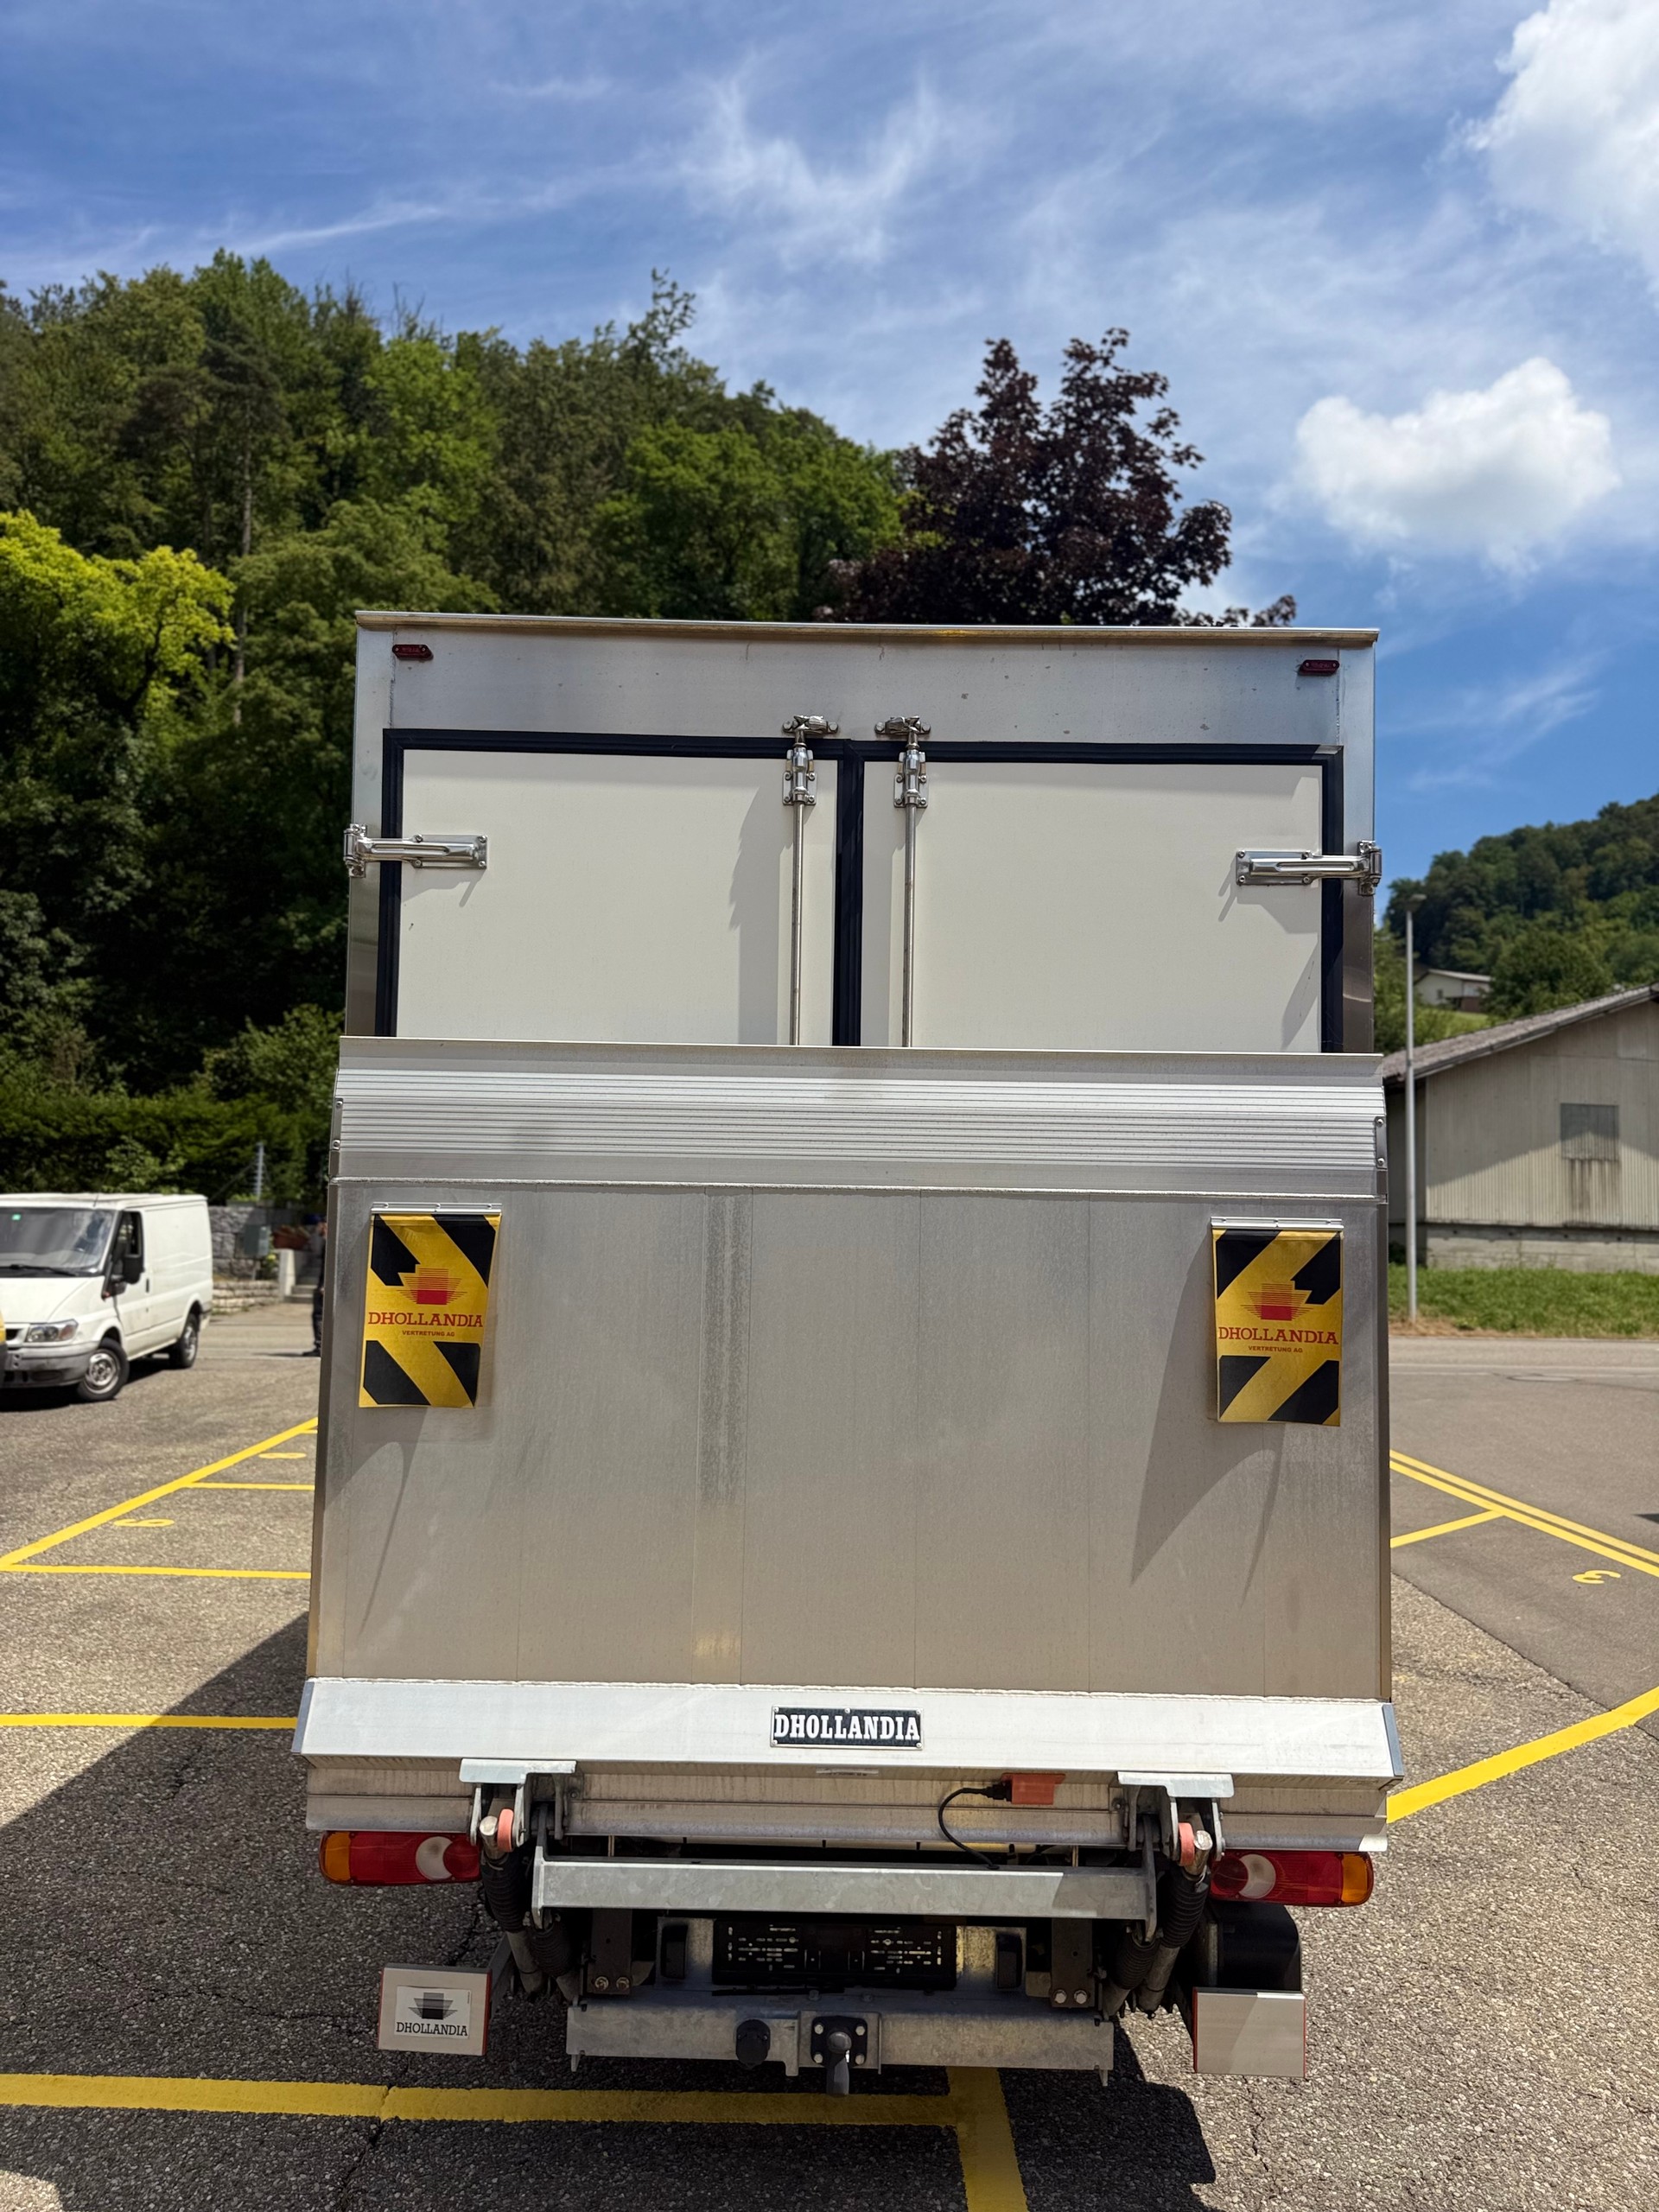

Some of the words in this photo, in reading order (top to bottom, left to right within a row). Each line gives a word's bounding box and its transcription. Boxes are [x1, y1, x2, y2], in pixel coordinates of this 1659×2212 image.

[367, 1312, 484, 1327] DHOLLANDIA
[1217, 1326, 1339, 1344] DHOLLANDIA
[1572, 1569, 1622, 1585] 3
[773, 1713, 921, 1741] DHOLLANDIA
[396, 2021, 468, 2037] DHOLLANDIA
